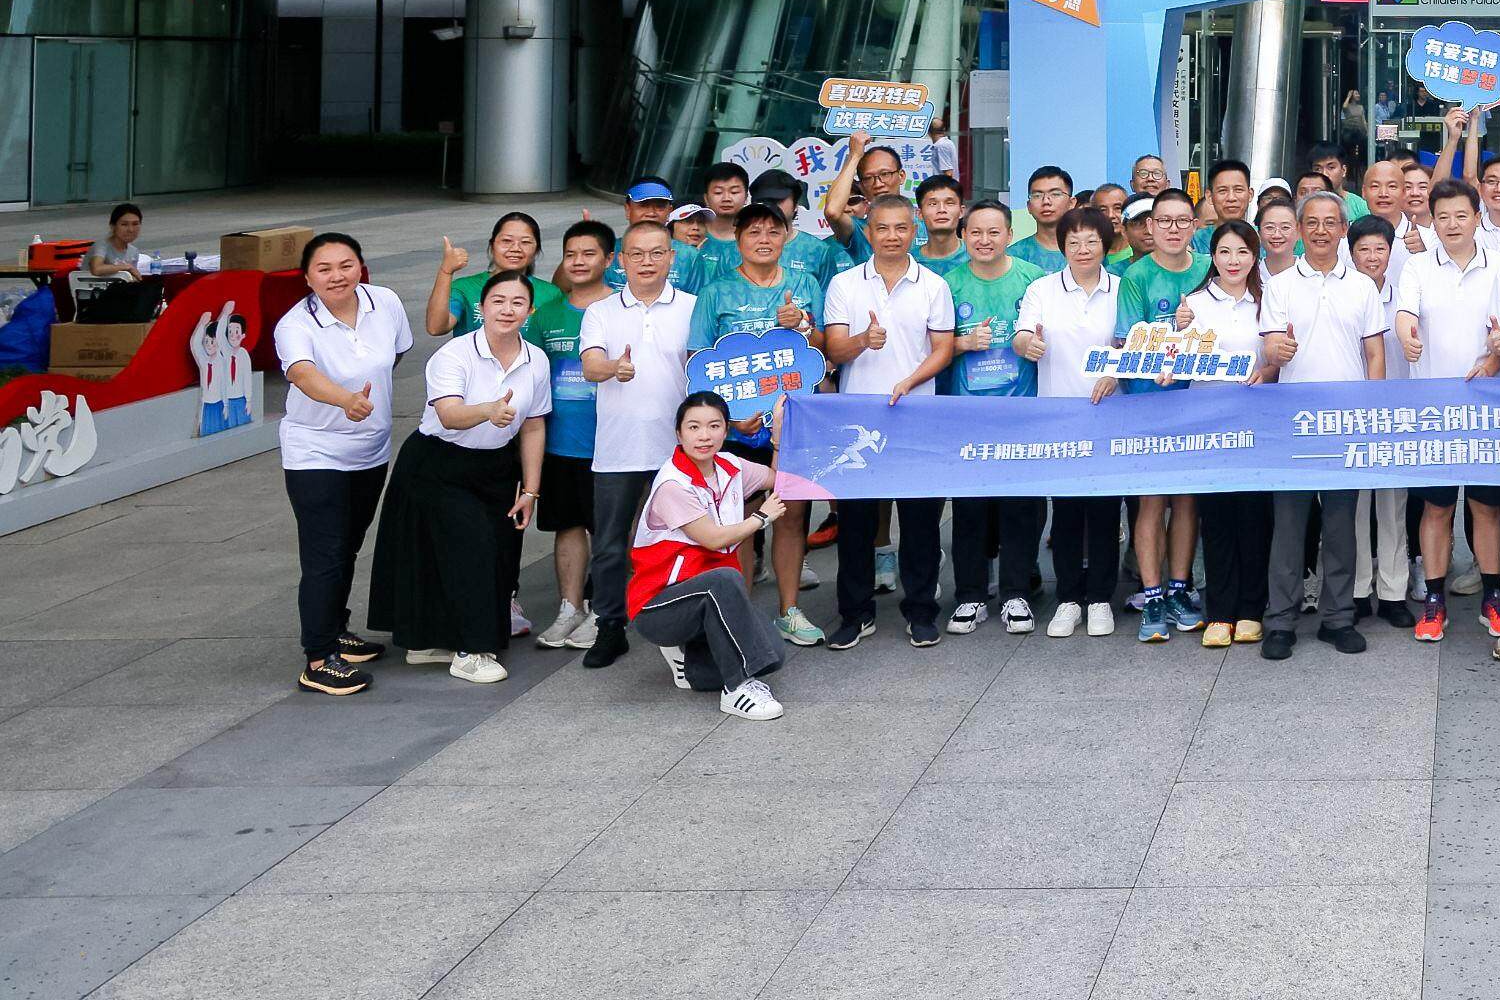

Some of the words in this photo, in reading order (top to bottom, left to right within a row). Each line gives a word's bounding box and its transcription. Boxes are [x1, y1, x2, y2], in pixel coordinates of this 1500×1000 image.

[1424, 38, 1499, 69] 有爱无碍
[1424, 59, 1498, 92] 传递梦想
[828, 83, 923, 107] 喜迎残特奥
[834, 110, 928, 133] 欢聚大湾区
[1129, 326, 1218, 354] 办好一个会
[704, 348, 795, 381] 有爱无碍
[713, 371, 803, 402] 传递梦想
[958, 440, 1094, 461] 心手相连迎残特奥
[1109, 430, 1255, 456] 同跑共庆500天启航
